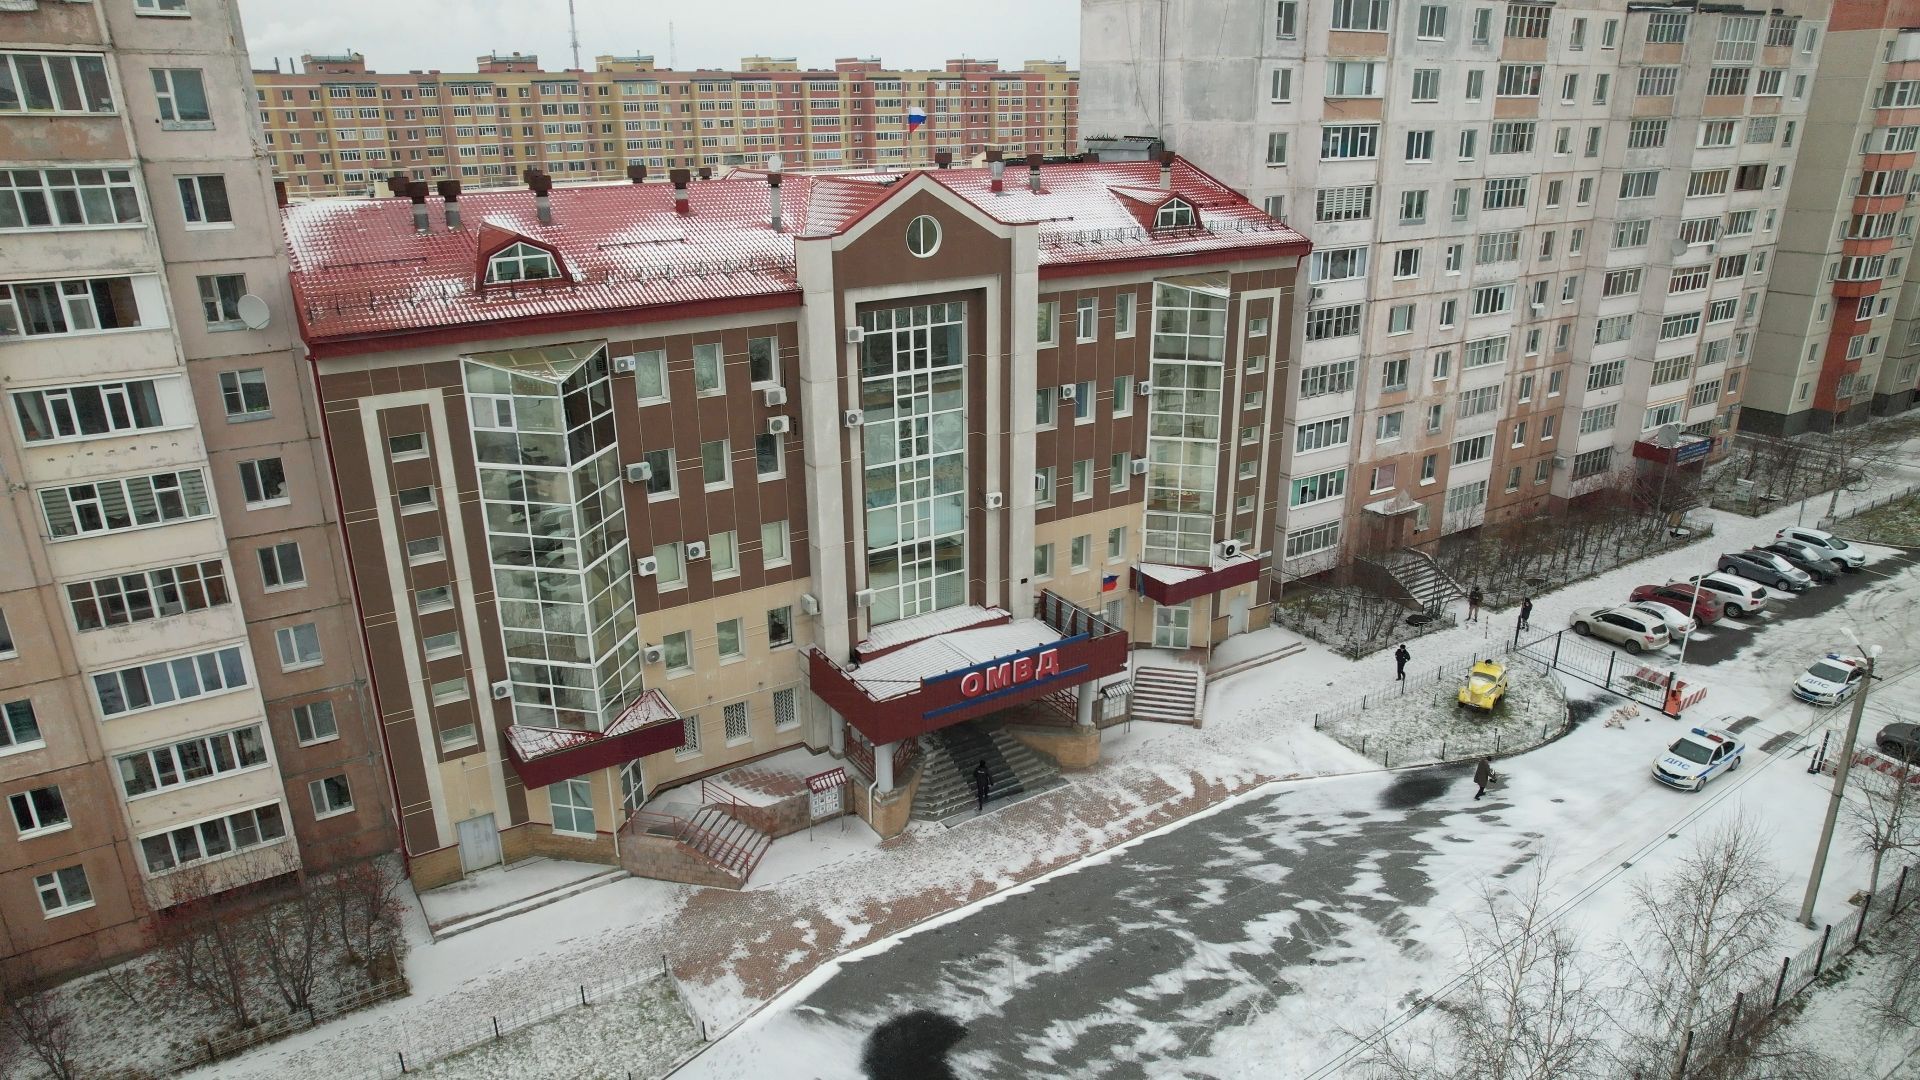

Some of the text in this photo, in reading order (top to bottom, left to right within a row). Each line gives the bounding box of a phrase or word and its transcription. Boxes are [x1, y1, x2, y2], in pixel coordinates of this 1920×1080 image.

[961, 648, 1060, 697] ОМВД
[1803, 678, 1830, 689] ДПС
[1664, 757, 1691, 770] ДПС
